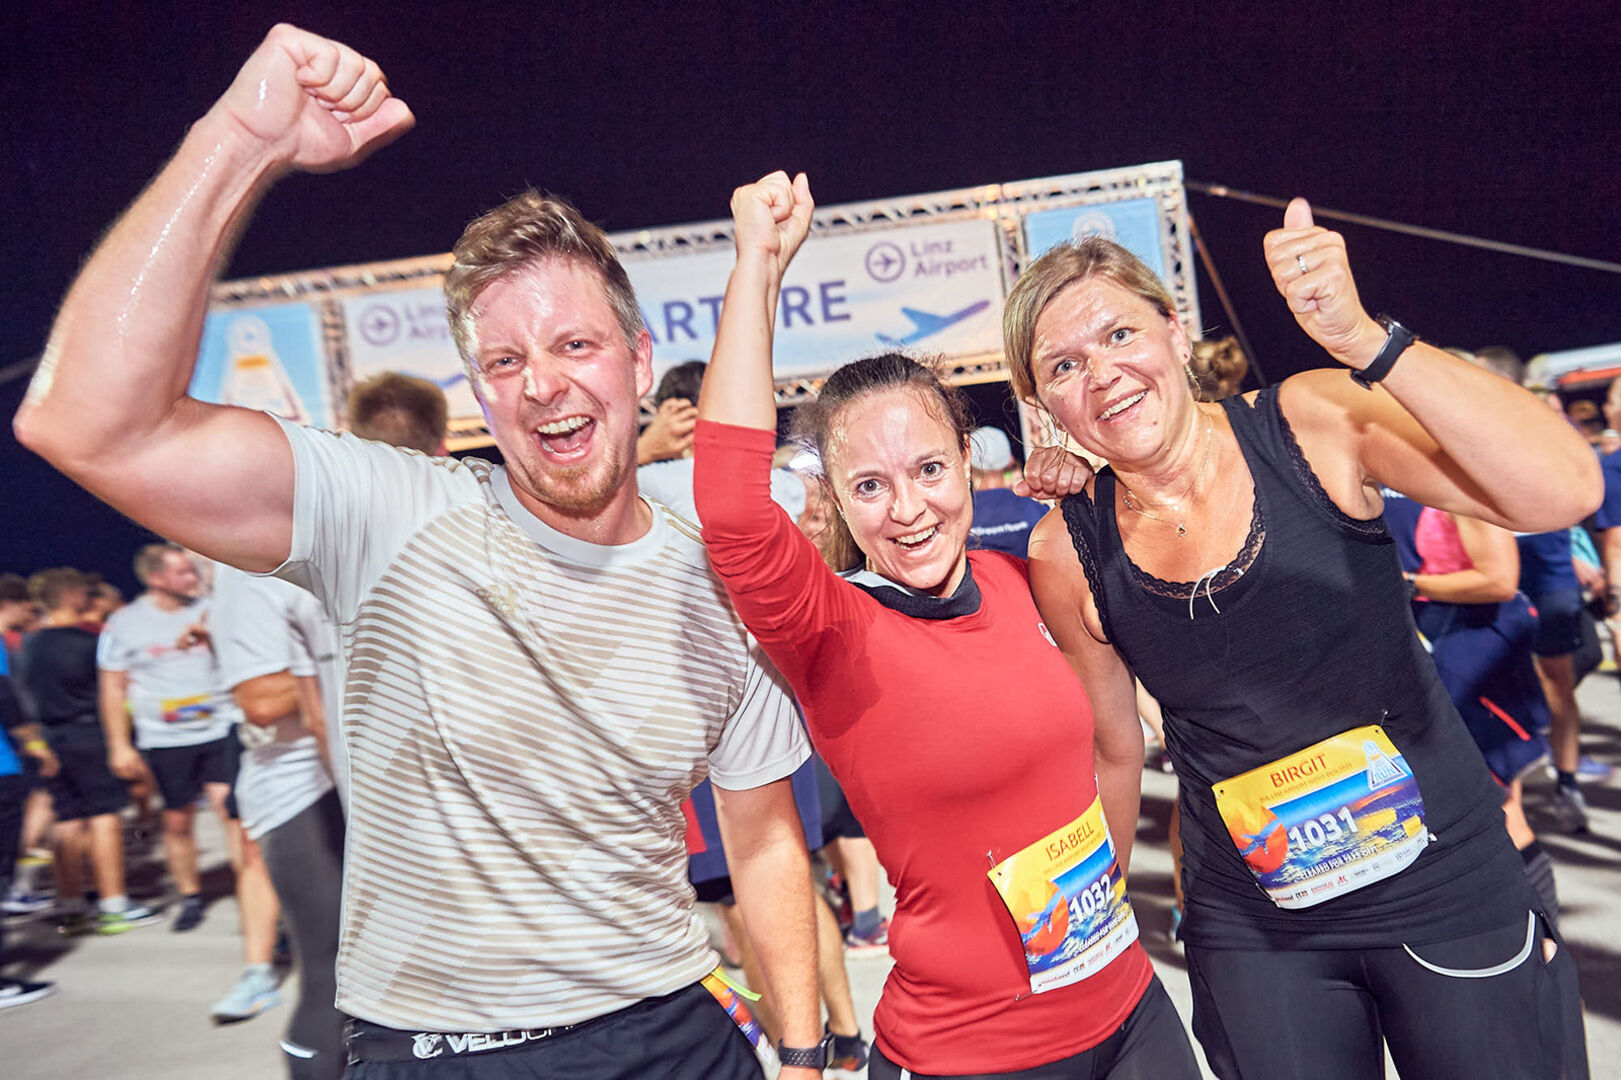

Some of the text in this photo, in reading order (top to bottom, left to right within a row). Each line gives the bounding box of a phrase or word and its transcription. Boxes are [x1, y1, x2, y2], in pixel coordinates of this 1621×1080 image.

[909, 239, 953, 257] Linz
[914, 253, 988, 277] Airport
[641, 280, 851, 344] RTRE
[1270, 753, 1327, 788] BIRGIT
[1045, 821, 1095, 862] ISABELL
[1287, 805, 1359, 853] 1031
[1069, 873, 1115, 921] 1032
